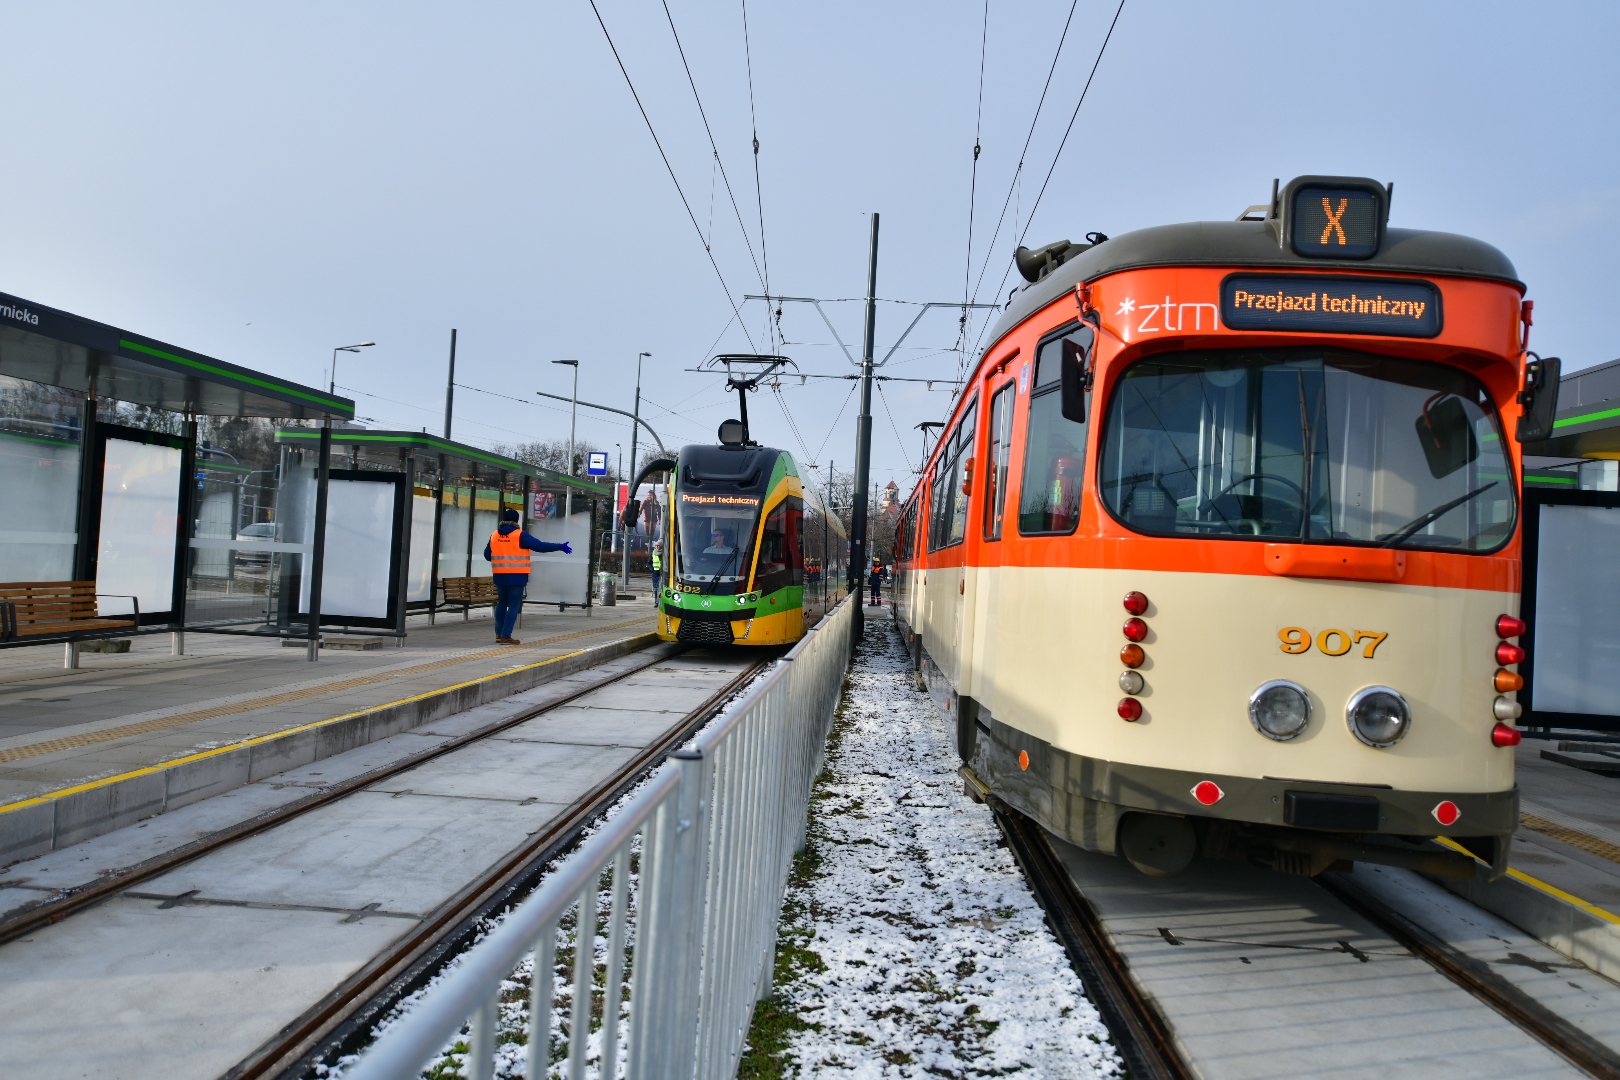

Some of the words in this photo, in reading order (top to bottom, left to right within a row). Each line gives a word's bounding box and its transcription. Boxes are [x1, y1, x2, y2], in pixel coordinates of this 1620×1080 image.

[1320, 197, 1348, 245] X
[1234, 290, 1317, 313] Przejazd
[1321, 293, 1426, 320] techniczny
[682, 494, 716, 504] Przejazd
[717, 495, 759, 506] techniczny
[675, 583, 702, 594] 602
[1277, 626, 1389, 659] 907
